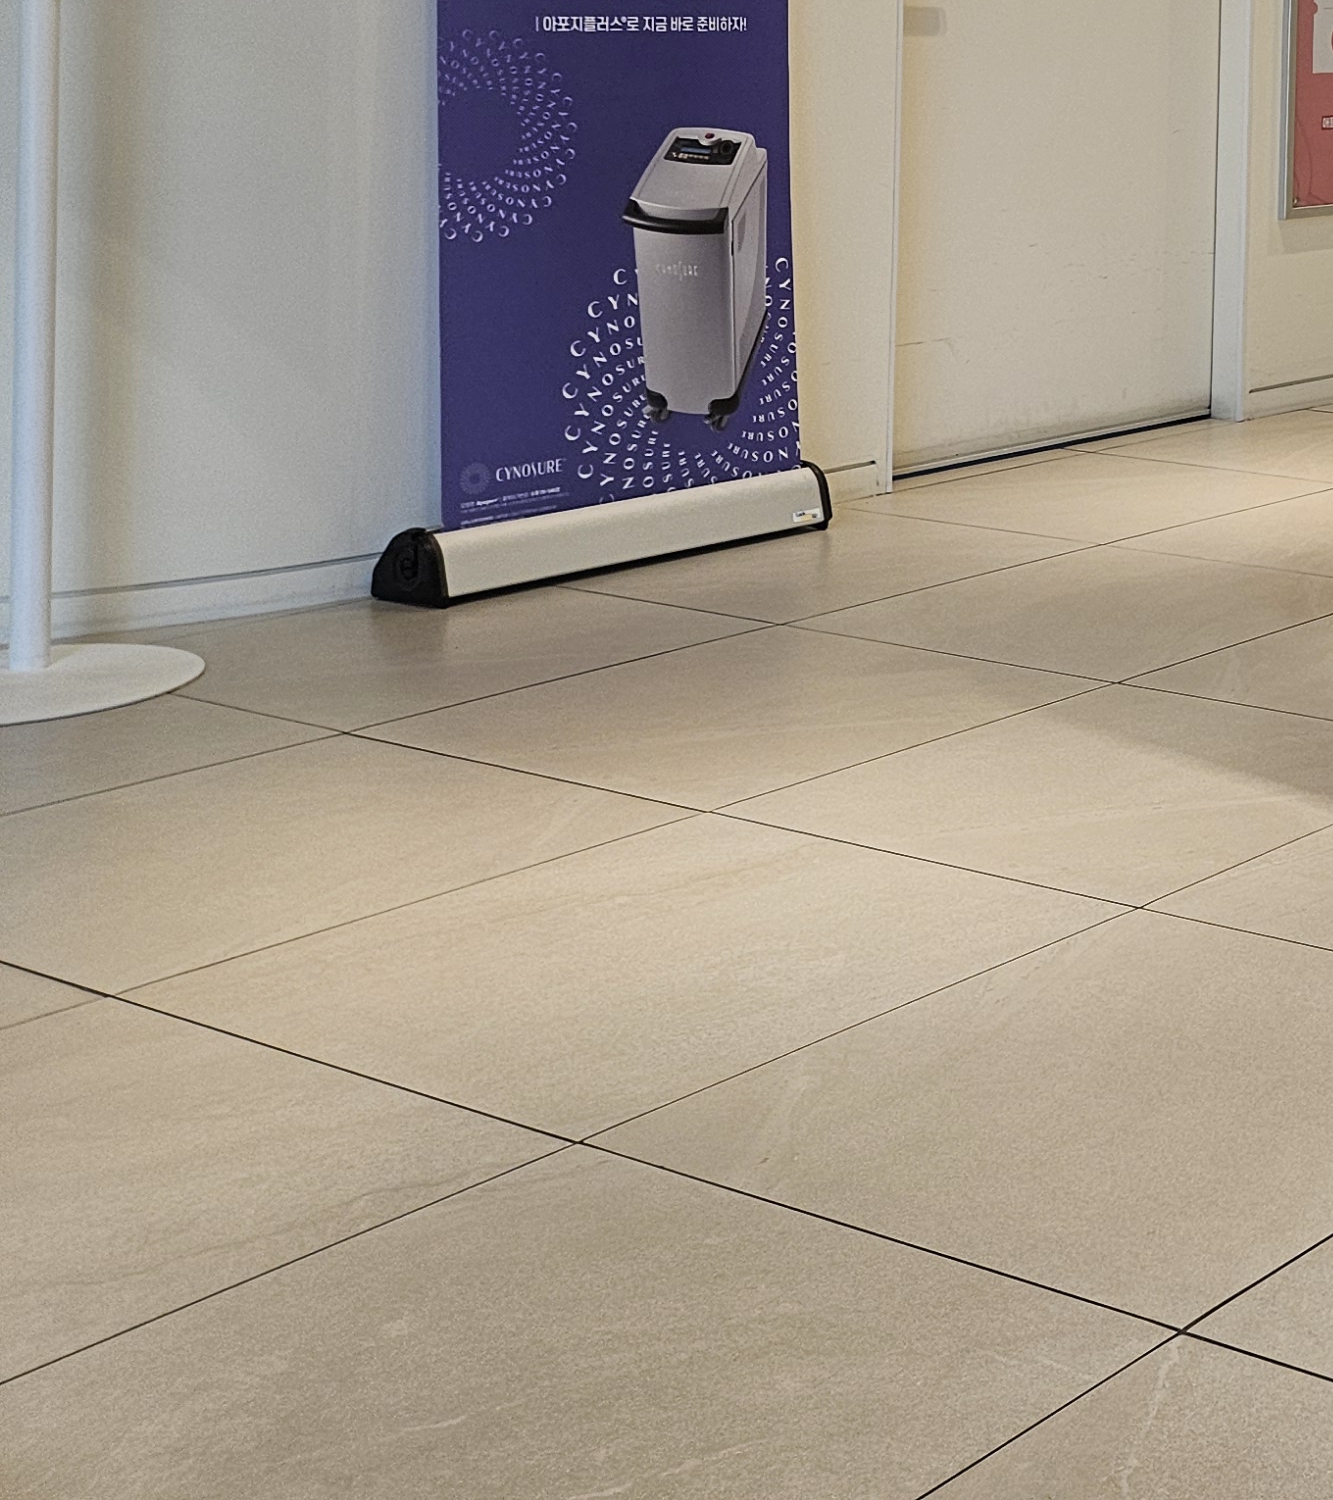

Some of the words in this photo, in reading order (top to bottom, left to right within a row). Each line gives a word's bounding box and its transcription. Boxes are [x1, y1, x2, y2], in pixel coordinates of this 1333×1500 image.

[643, 16, 668, 32] 지금
[670, 16, 694, 32] 바로
[697, 16, 747, 32] 준비하자!
